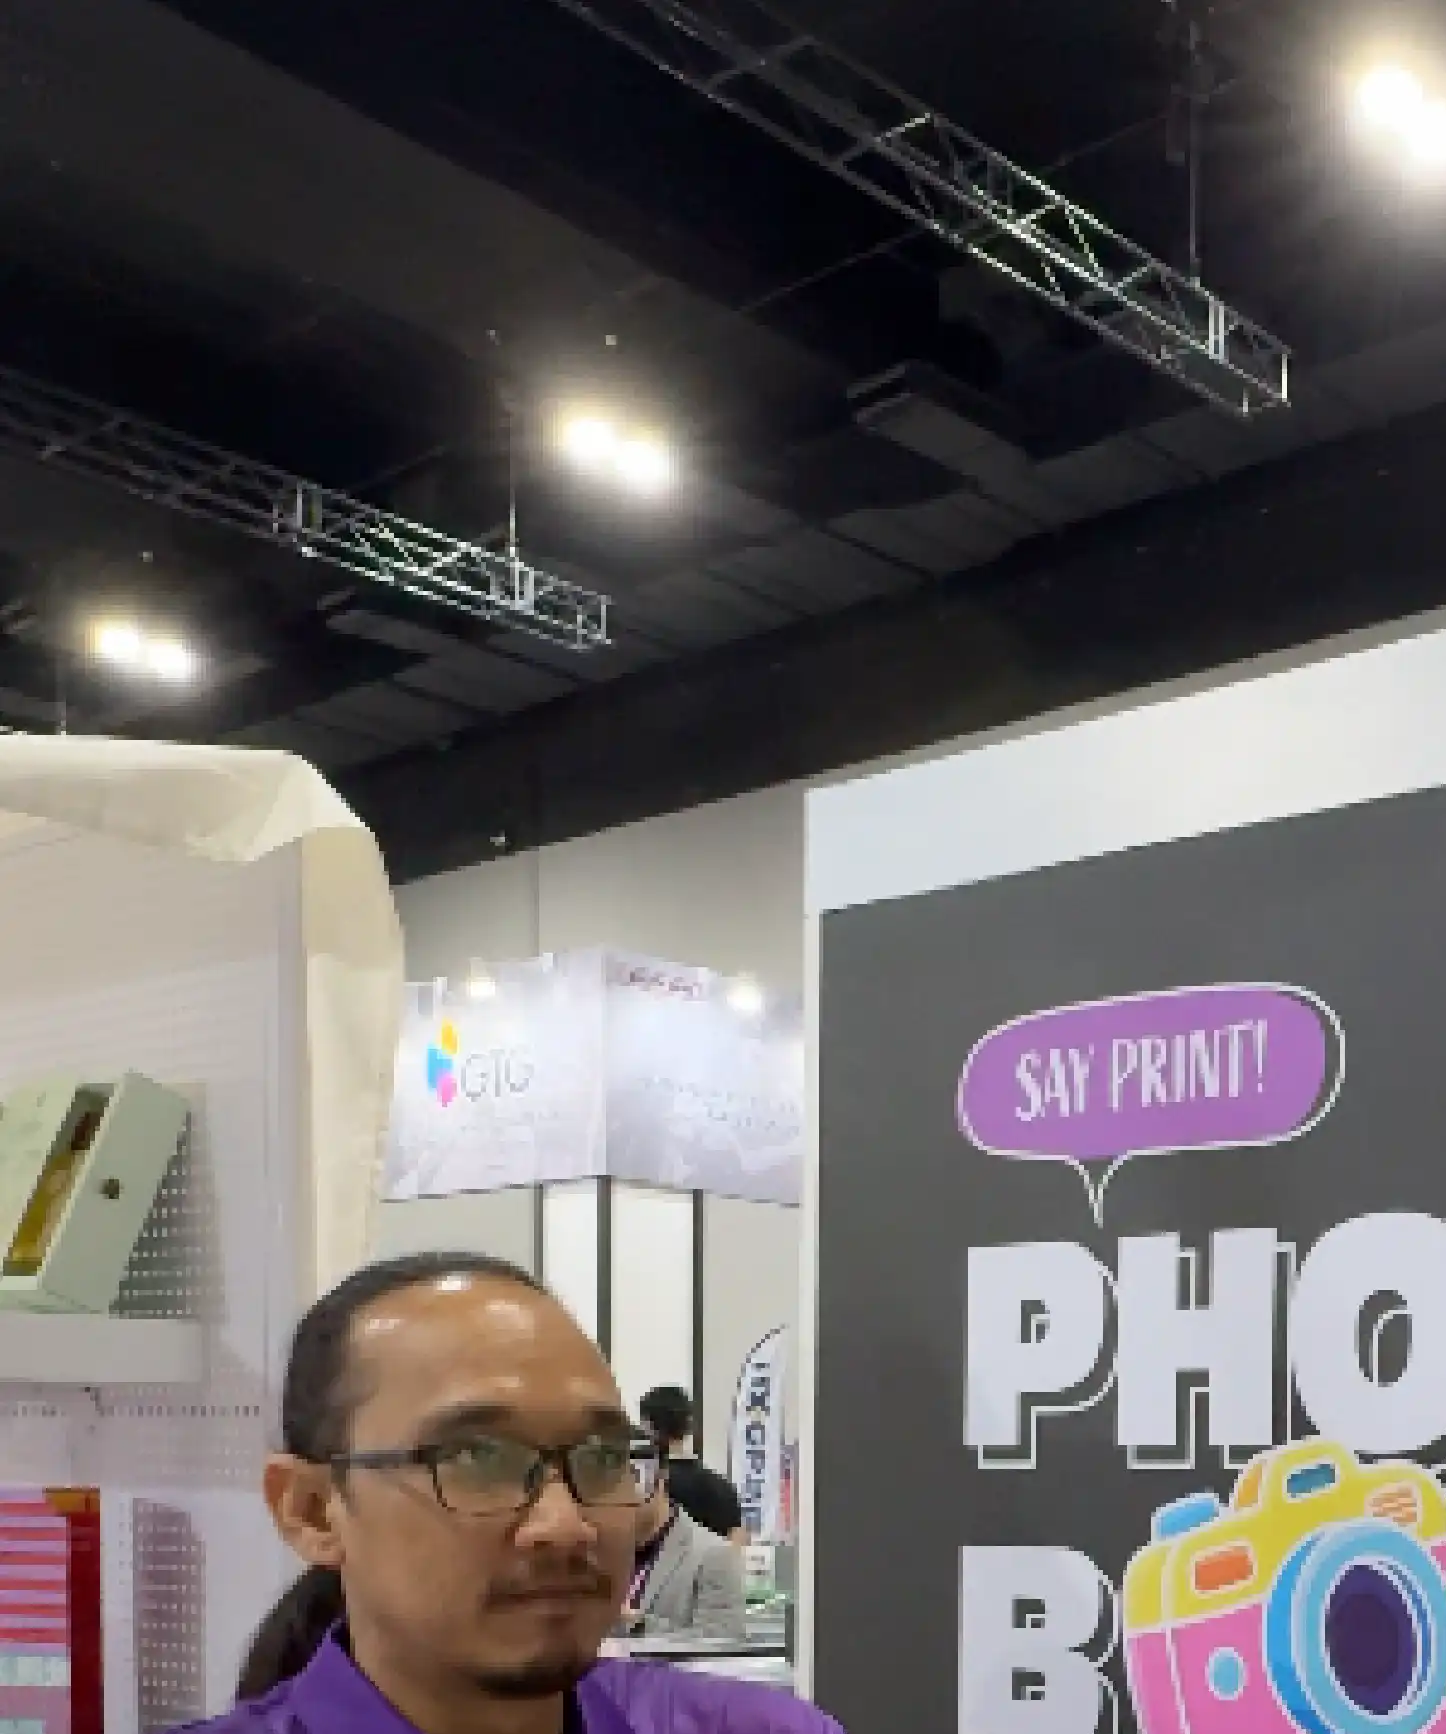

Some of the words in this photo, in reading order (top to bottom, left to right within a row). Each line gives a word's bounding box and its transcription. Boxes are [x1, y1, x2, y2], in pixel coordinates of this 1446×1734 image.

[461, 1049, 534, 1102] GTG
[1014, 1043, 1095, 1121] SAY
[1109, 1018, 1268, 1113] PRINT!
